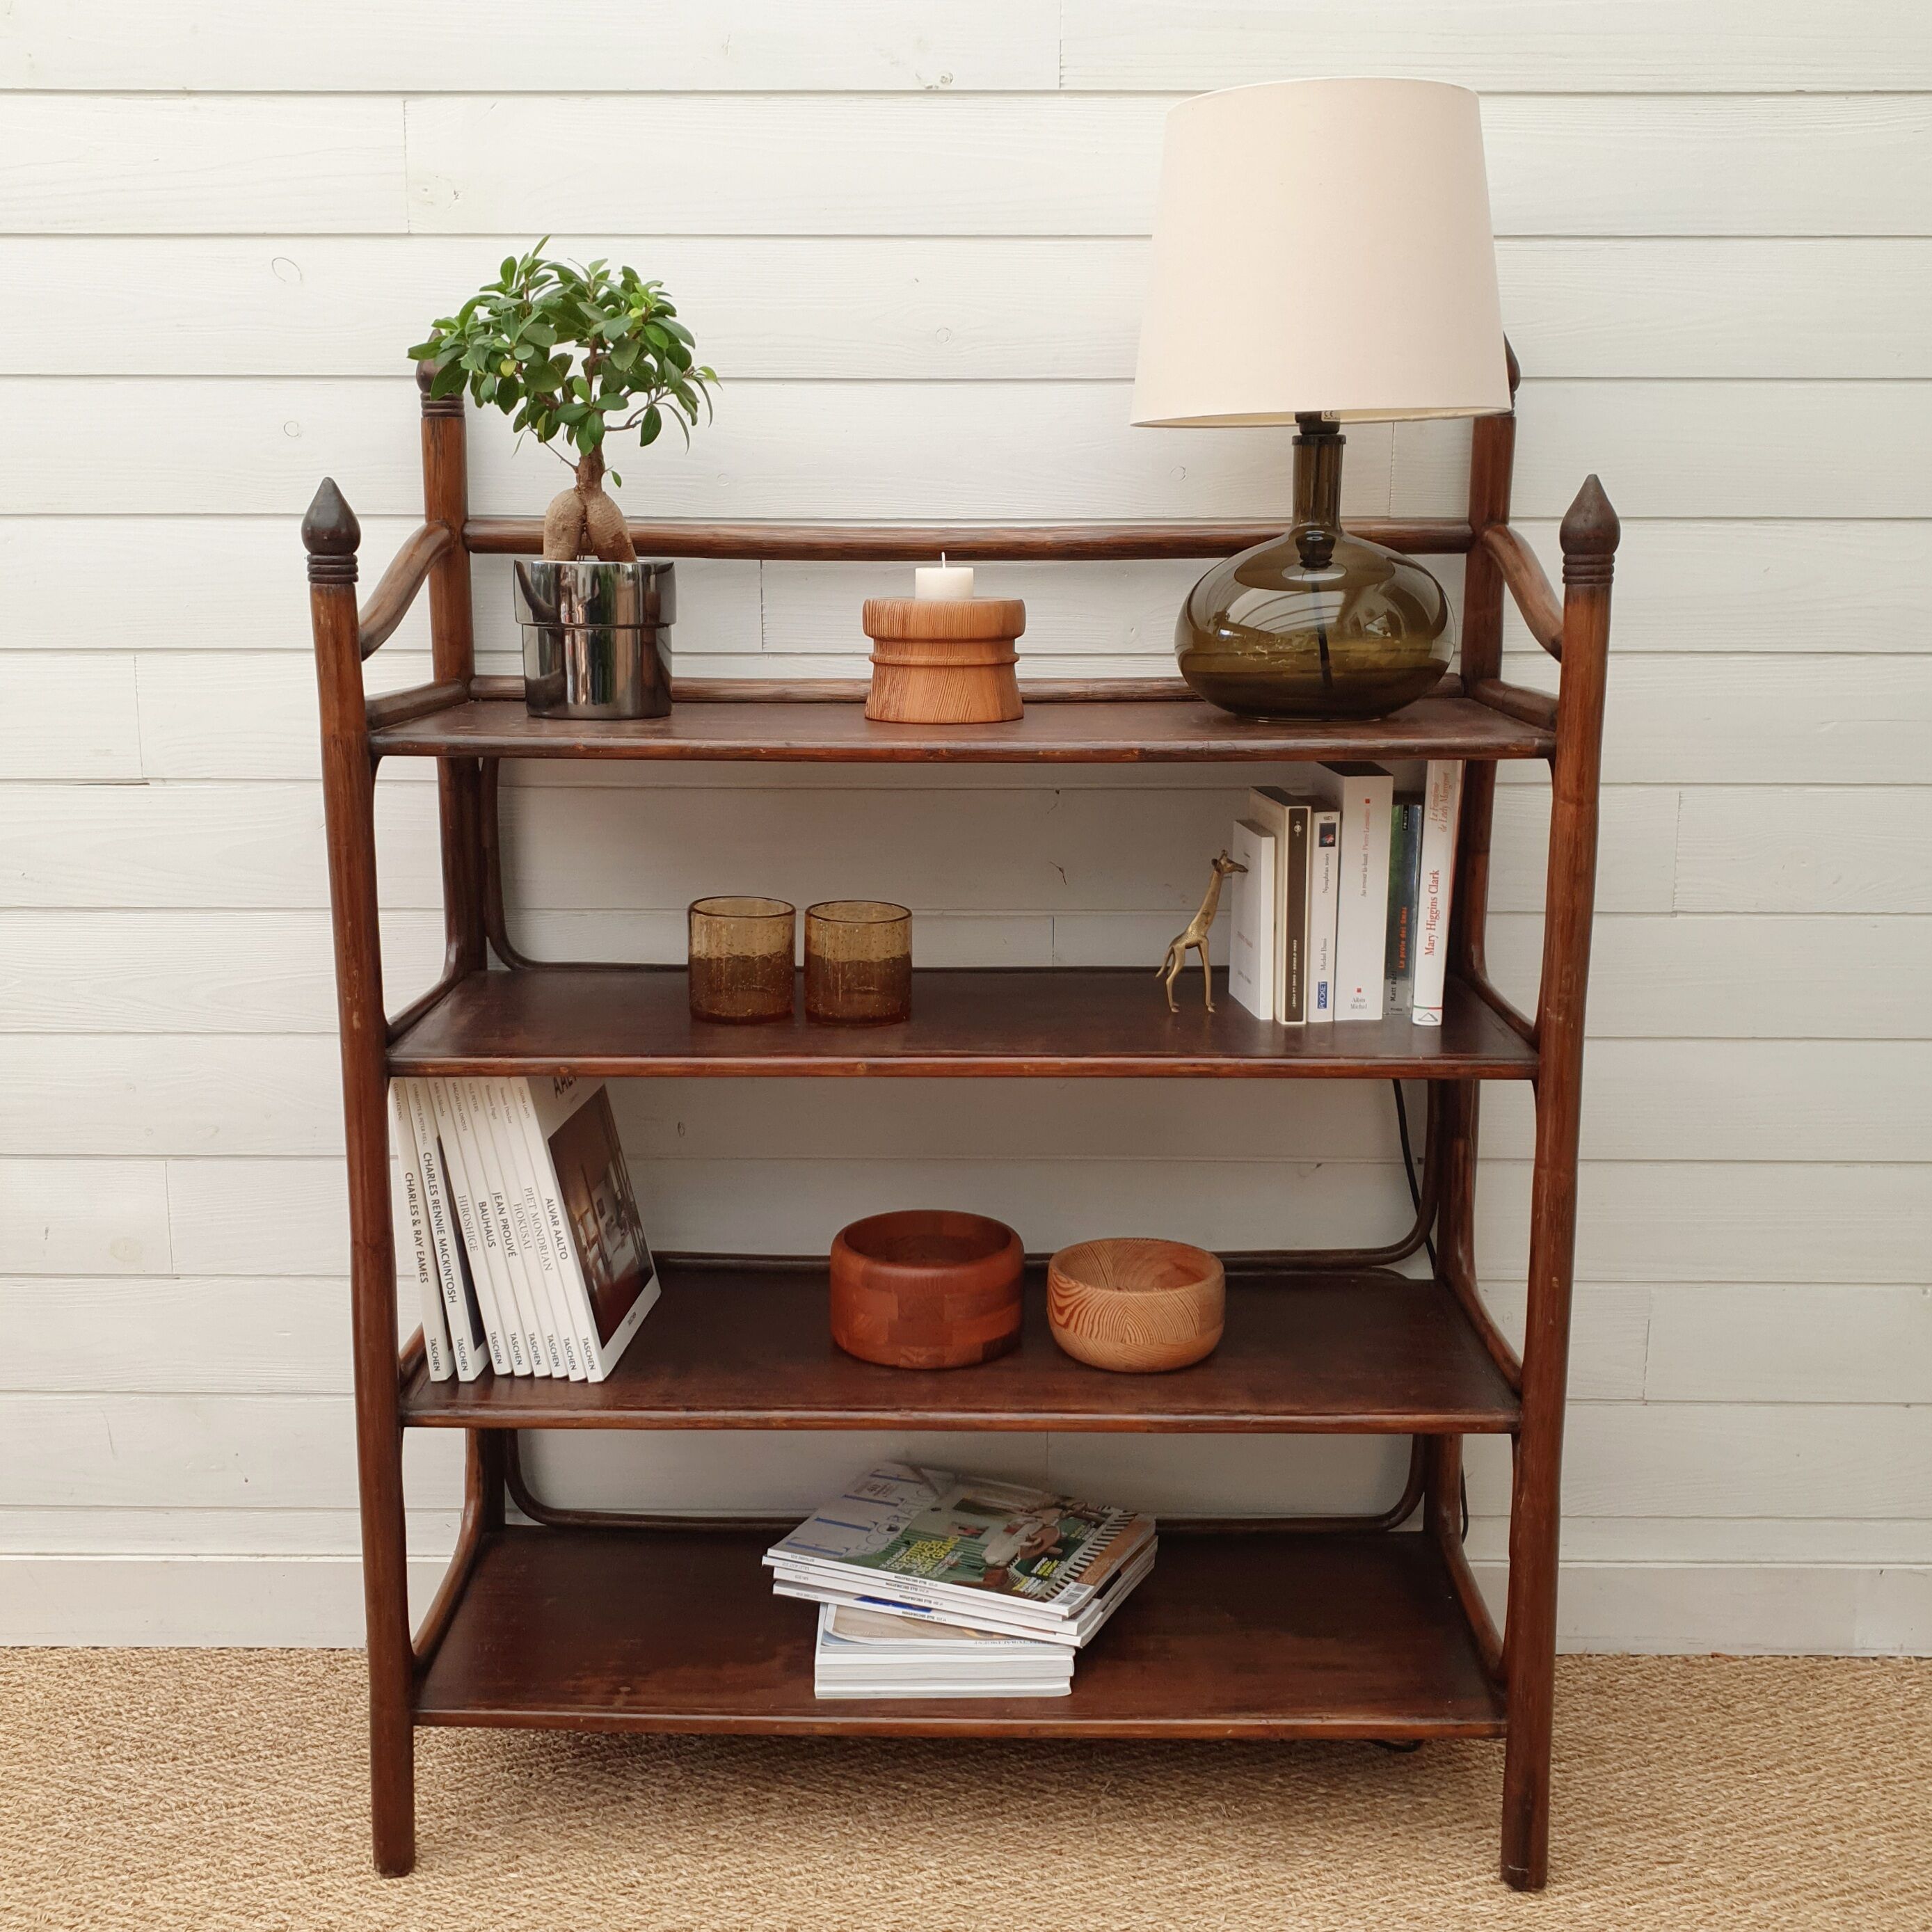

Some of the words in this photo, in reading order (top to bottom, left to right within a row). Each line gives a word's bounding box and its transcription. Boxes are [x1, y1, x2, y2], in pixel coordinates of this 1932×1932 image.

[1429, 812, 1438, 821] Le
[1439, 806, 1450, 822] Lady
[1439, 824, 1448, 833] de
[1428, 870, 1440, 894] Clark
[1426, 896, 1440, 931] Higgins
[1424, 932, 1439, 956] Mary
[1318, 981, 1327, 1008] POCKET
[553, 1076, 577, 1099] AAL
[423, 1151, 438, 1197] CHARLES
[405, 1172, 419, 1216] CHARLES
[524, 1187, 538, 1209] PIET
[431, 1199, 446, 1236] RENNIE
[458, 1195, 479, 1252] HIROSHIGE
[478, 1201, 497, 1249] BAUHAUS
[491, 1192, 506, 1215] JEAN
[500, 1218, 518, 1258] PROUVÉ
[513, 1202, 533, 1250] HOKUSAI
[545, 1197, 560, 1227] ALVAR
[553, 1229, 568, 1260] AALTO
[414, 1230, 424, 1247] RAY
[530, 1212, 552, 1272] MONDRIAN
[416, 1251, 429, 1284] EAMES
[438, 1238, 457, 1304] MACKINTOSH
[430, 1337, 440, 1371] TASCHEN
[456, 1337, 469, 1371] TASCHEN
[489, 1331, 503, 1364] TASCHEN
[510, 1332, 522, 1366] TASCHEN
[529, 1332, 542, 1366] TASCHEN
[547, 1334, 561, 1368] TASCHEN
[563, 1336, 577, 1371] TASCHEN
[582, 1336, 596, 1371] TASCHEN
[785, 1469, 925, 1557] ELLE
[931, 1535, 961, 1559] GRAND
